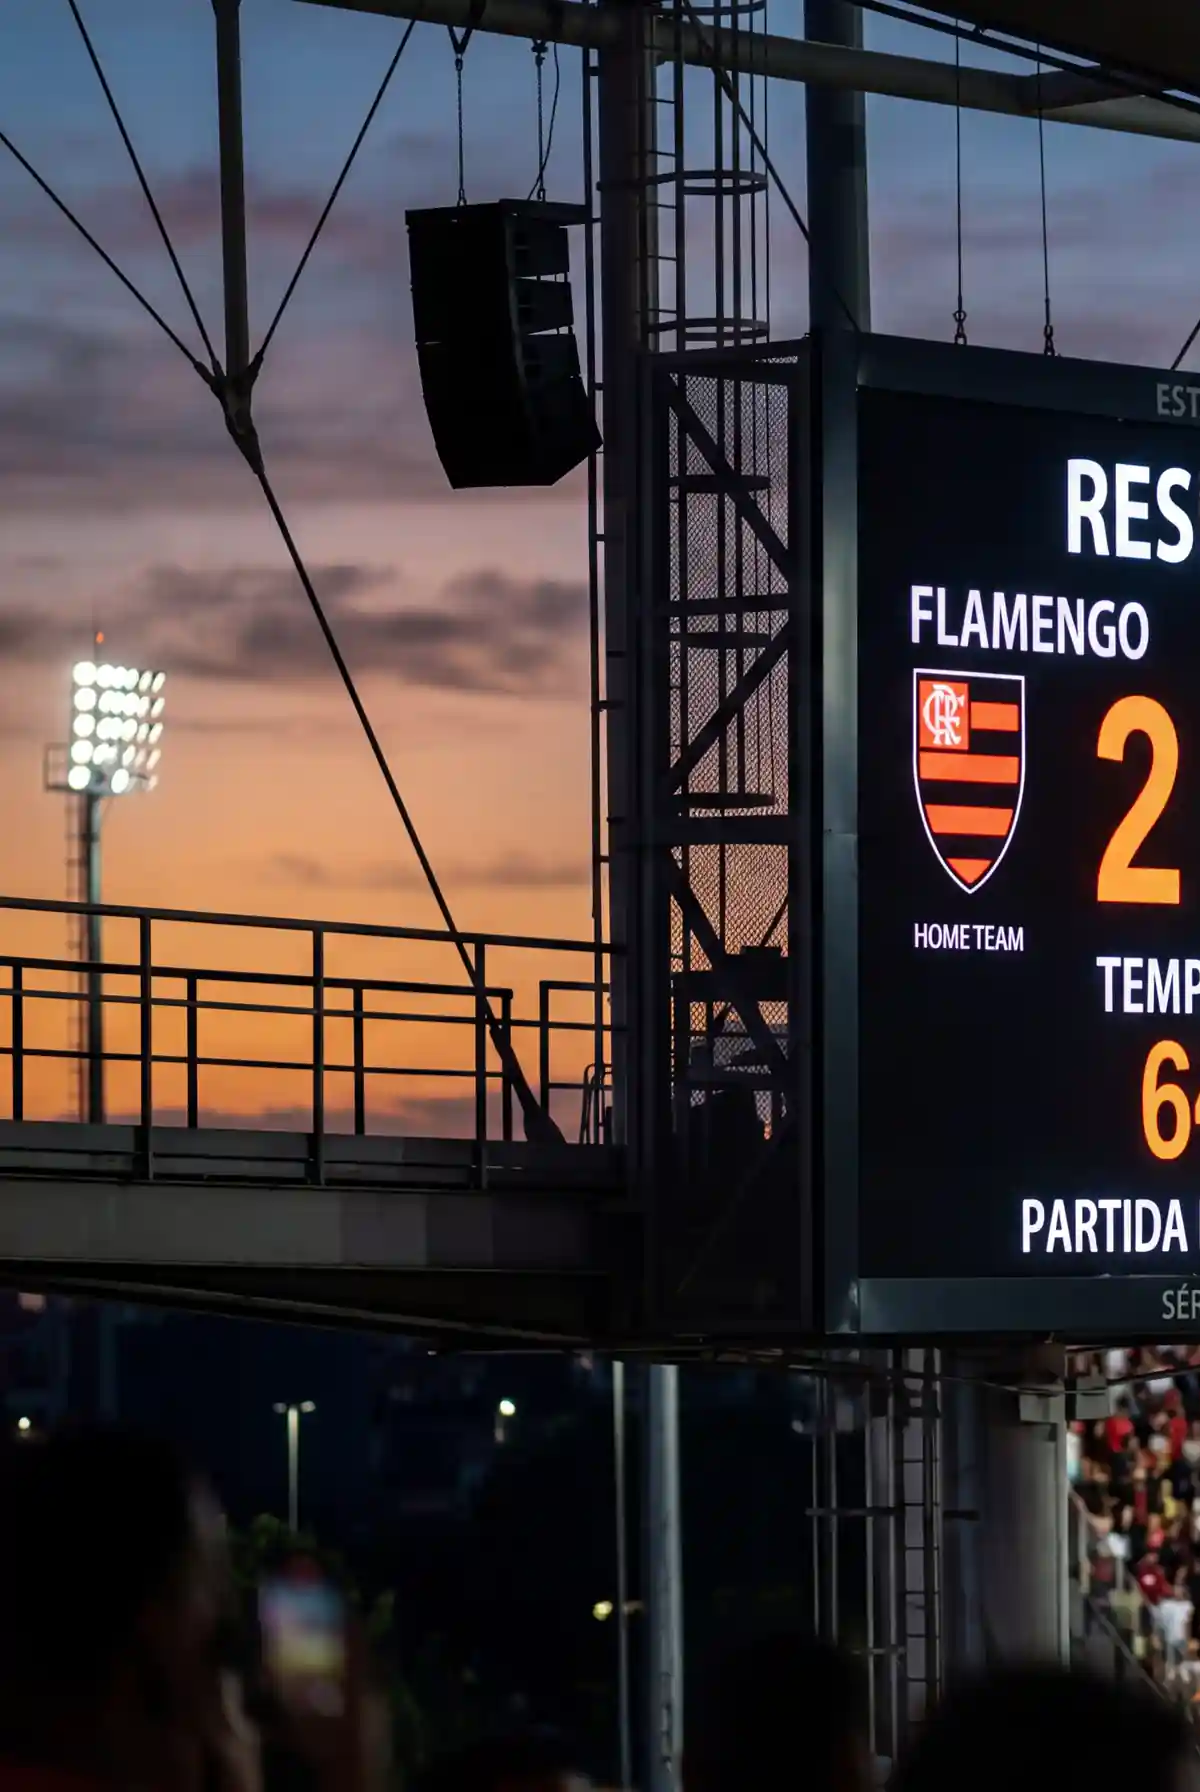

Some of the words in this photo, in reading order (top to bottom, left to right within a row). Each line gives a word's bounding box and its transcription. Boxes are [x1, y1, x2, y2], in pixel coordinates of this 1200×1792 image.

[910, 585, 1150, 660] FLAMENGO
[1097, 695, 1181, 905] 2
[914, 922, 970, 950] HOME
[971, 924, 1024, 952] TEAM
[1022, 1198, 1189, 1253] PARTIDA
